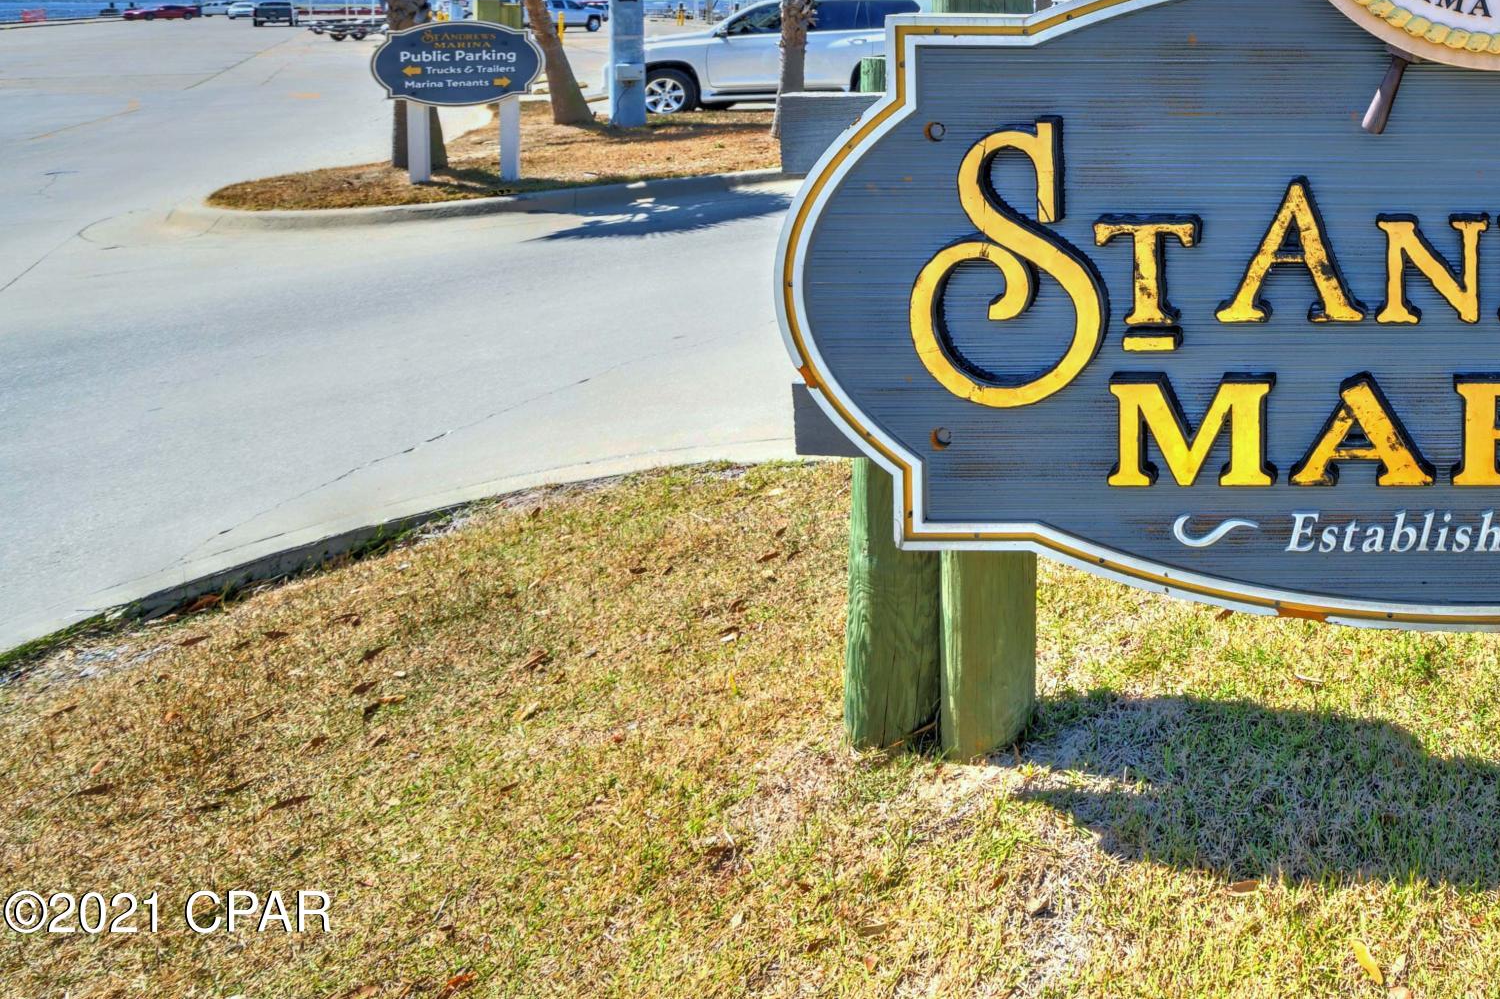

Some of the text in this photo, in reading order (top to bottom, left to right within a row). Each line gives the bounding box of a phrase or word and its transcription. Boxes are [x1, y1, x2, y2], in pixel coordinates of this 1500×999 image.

[400, 50, 517, 63] Public Parking
[426, 65, 516, 75] Trucks & Trailers
[405, 79, 489, 89] Marina Tenants
